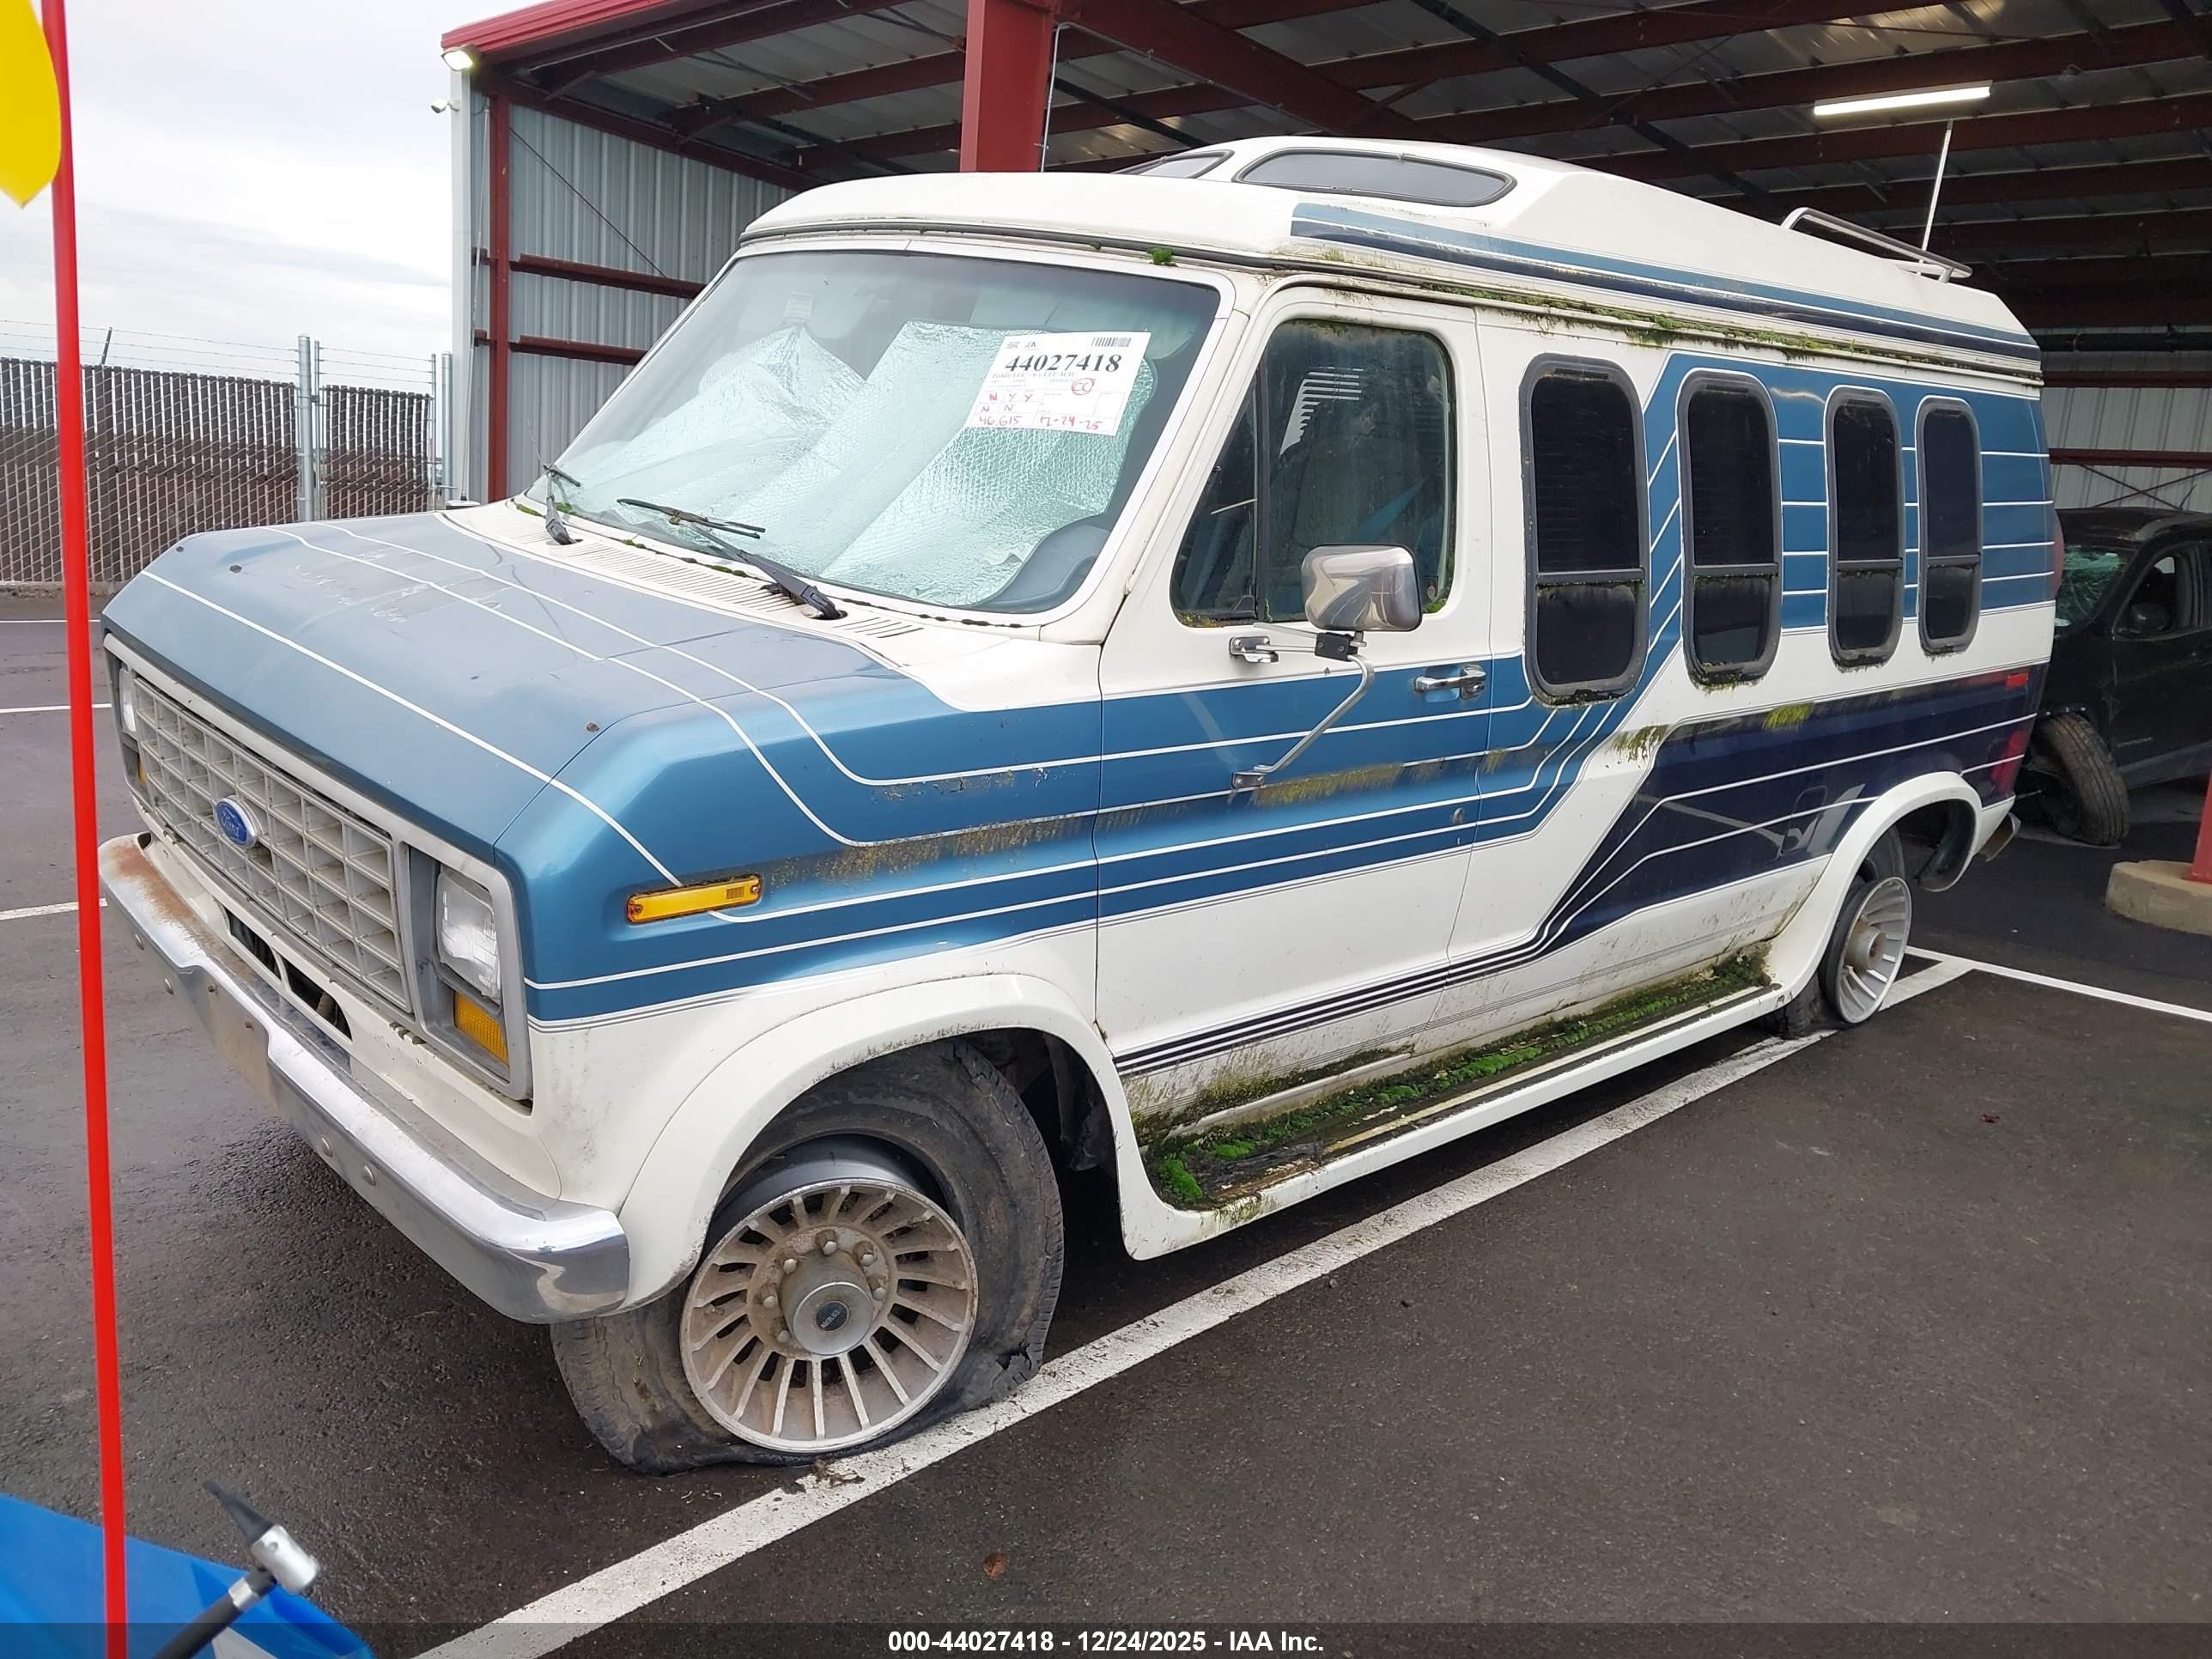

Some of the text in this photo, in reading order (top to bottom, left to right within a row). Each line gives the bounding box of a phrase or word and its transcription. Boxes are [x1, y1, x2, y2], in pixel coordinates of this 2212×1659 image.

[1005, 353, 1122, 373] 44027418
[1009, 393, 1017, 402] Y
[1024, 392, 1034, 403] Y
[981, 403, 1014, 413] N N
